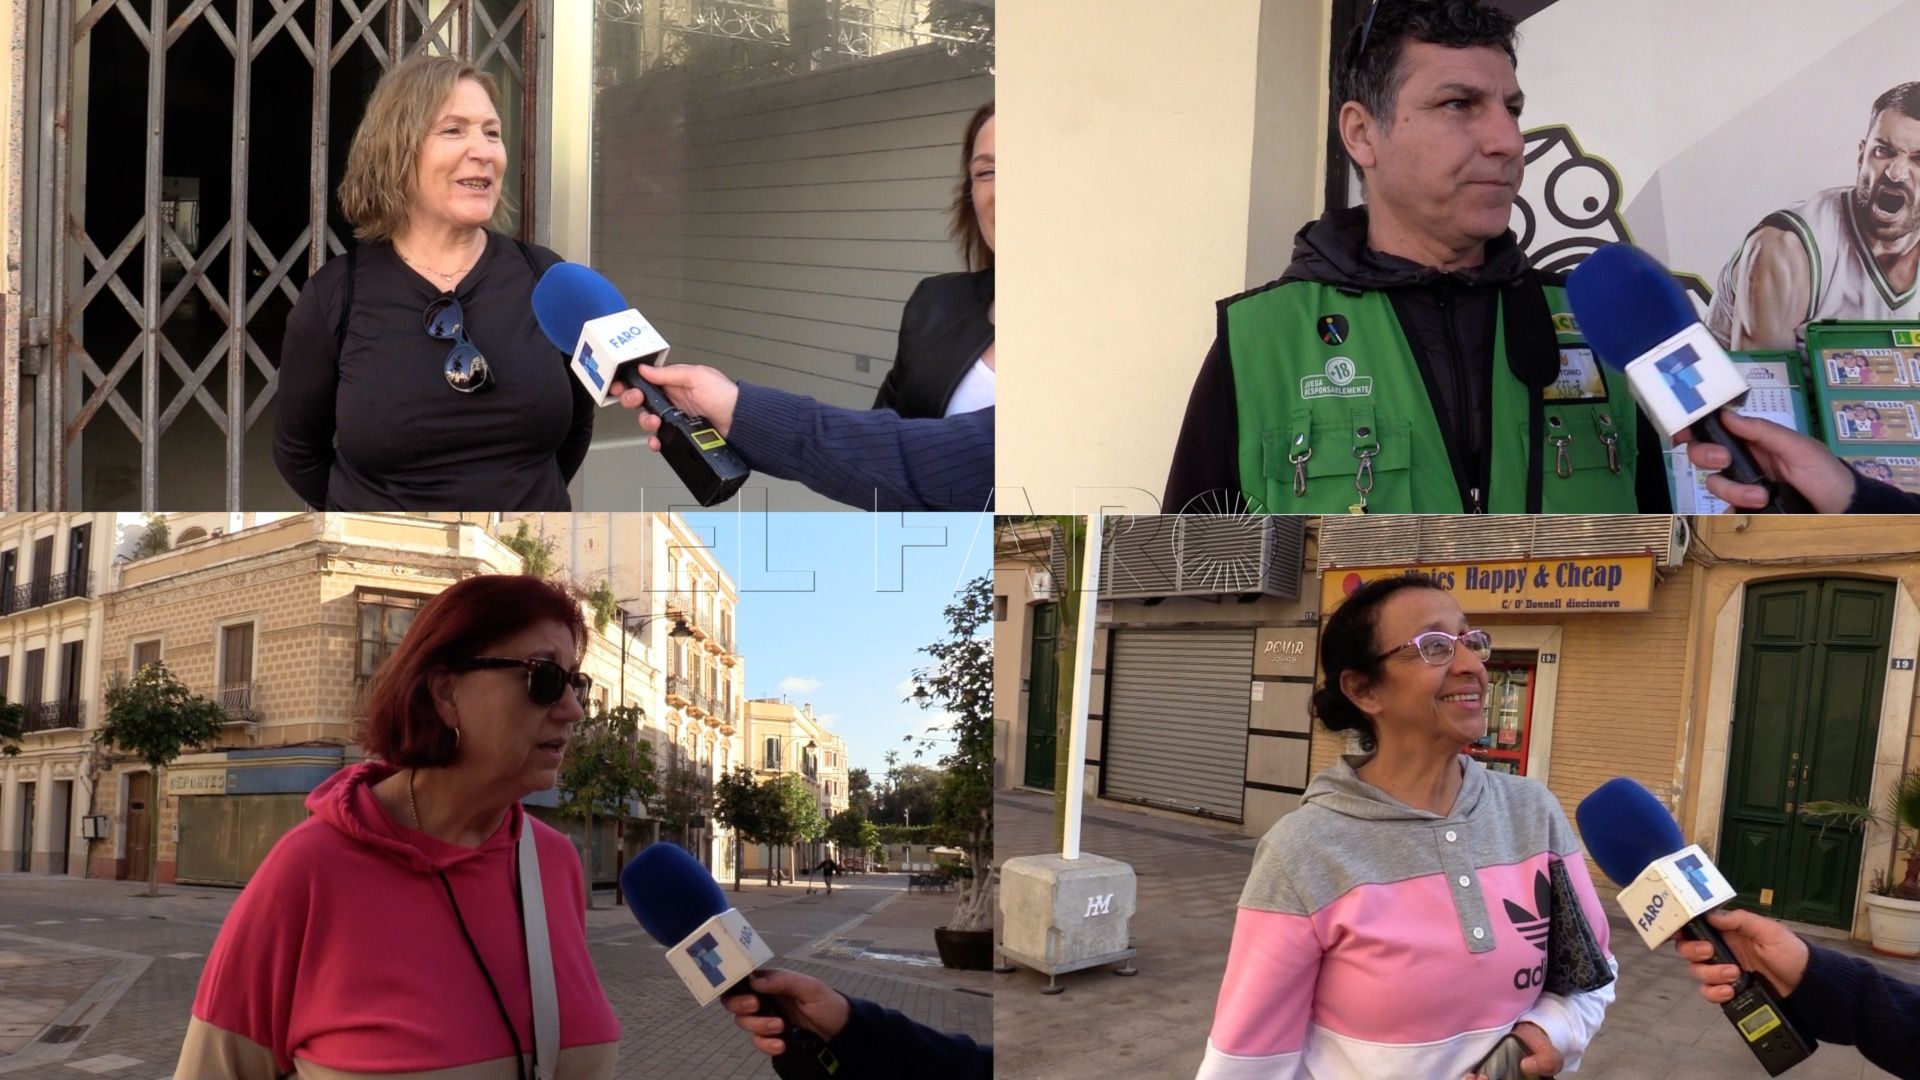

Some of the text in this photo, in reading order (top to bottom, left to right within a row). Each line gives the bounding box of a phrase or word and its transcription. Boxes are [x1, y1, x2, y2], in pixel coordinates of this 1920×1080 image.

[609, 326, 642, 349] FARO
[1331, 362, 1351, 380] +18
[1559, 368, 1582, 376] TONIO
[1304, 380, 1323, 389] JUEGA
[1304, 386, 1369, 397] RESPONSABLEMENTE
[1465, 566, 1528, 594] Happy
[1533, 564, 1550, 588] &
[1556, 562, 1622, 591] Cheap
[1526, 598, 1562, 609] Donnell
[1566, 599, 1620, 609] diecinueve
[1895, 660, 1909, 669] 19
[1084, 893, 1114, 917] HM
[1638, 894, 1665, 932] FARO
